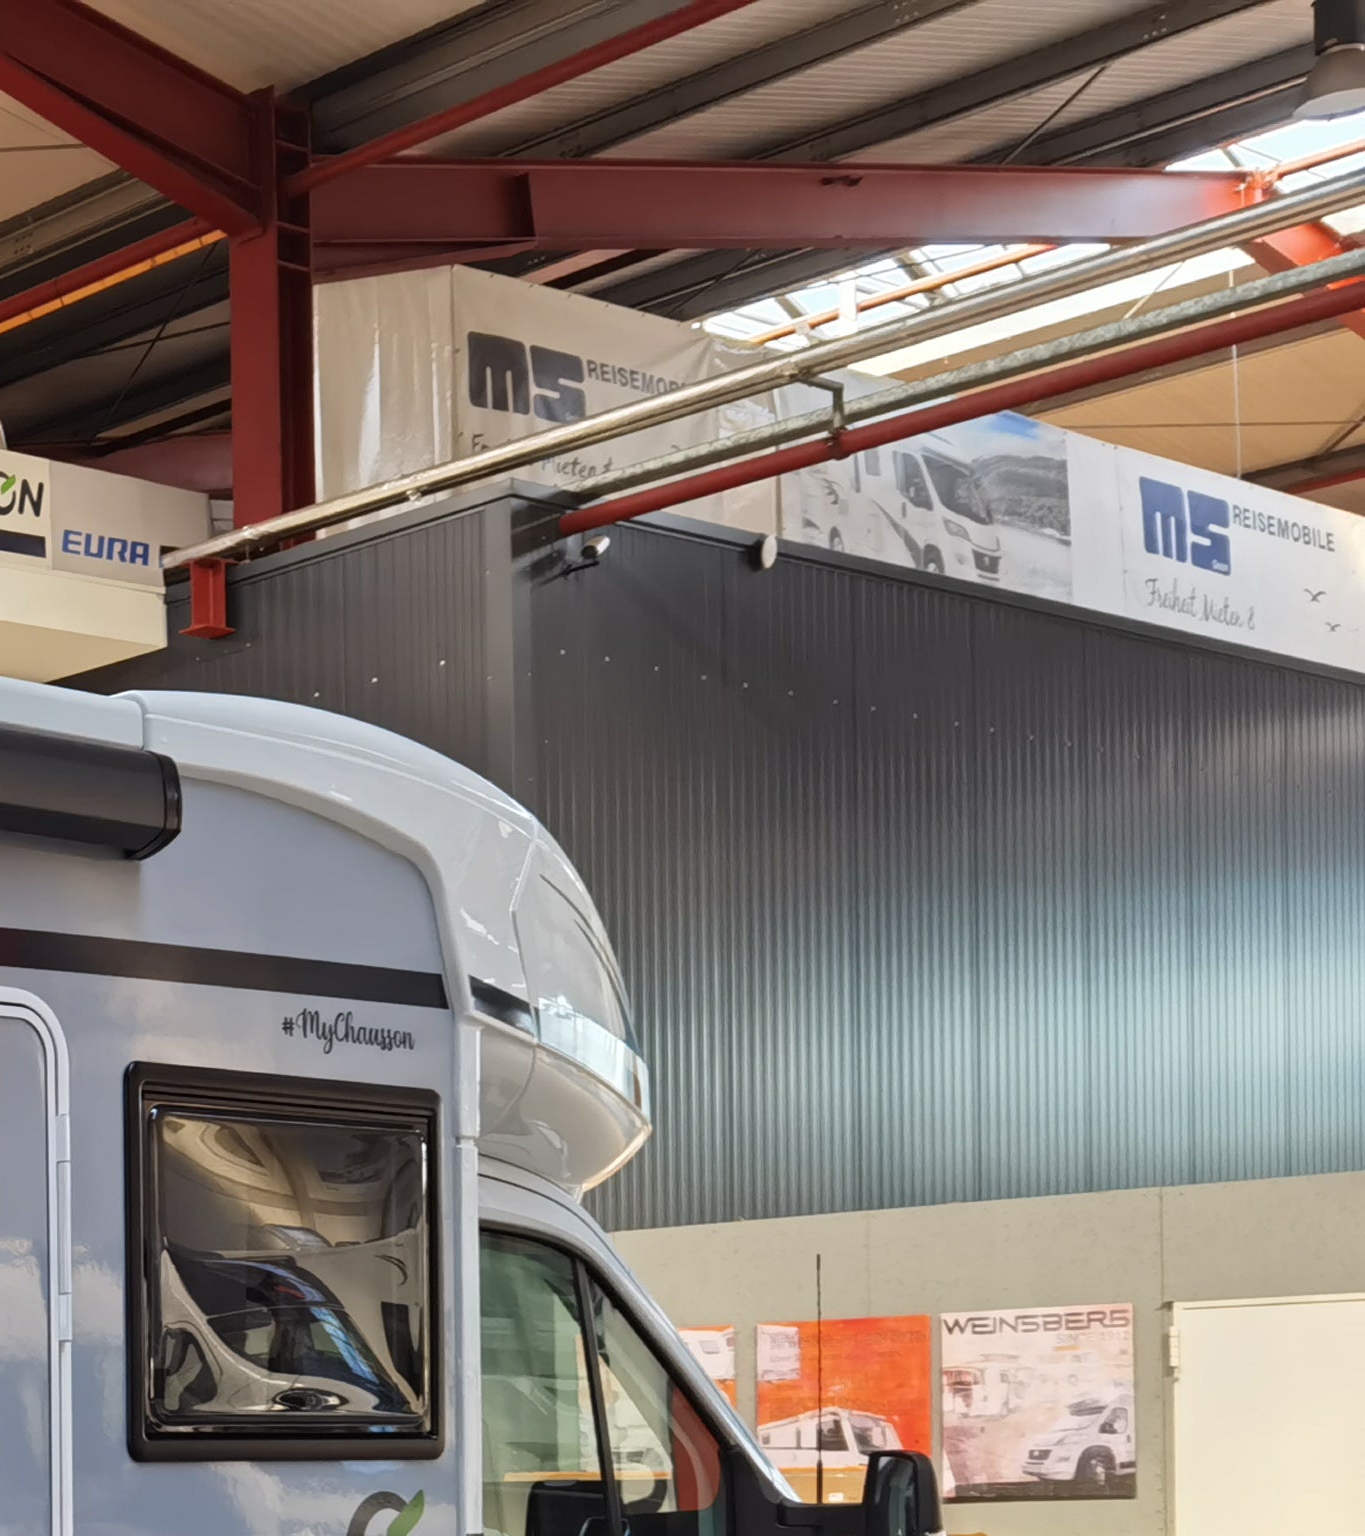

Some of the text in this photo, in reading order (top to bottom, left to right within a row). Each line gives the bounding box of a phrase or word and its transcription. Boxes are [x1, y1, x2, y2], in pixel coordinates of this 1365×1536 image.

[61, 529, 150, 567] EURA
[1233, 504, 1336, 552] REISEMOBILE
[281, 1008, 416, 1055] #MyChausson
